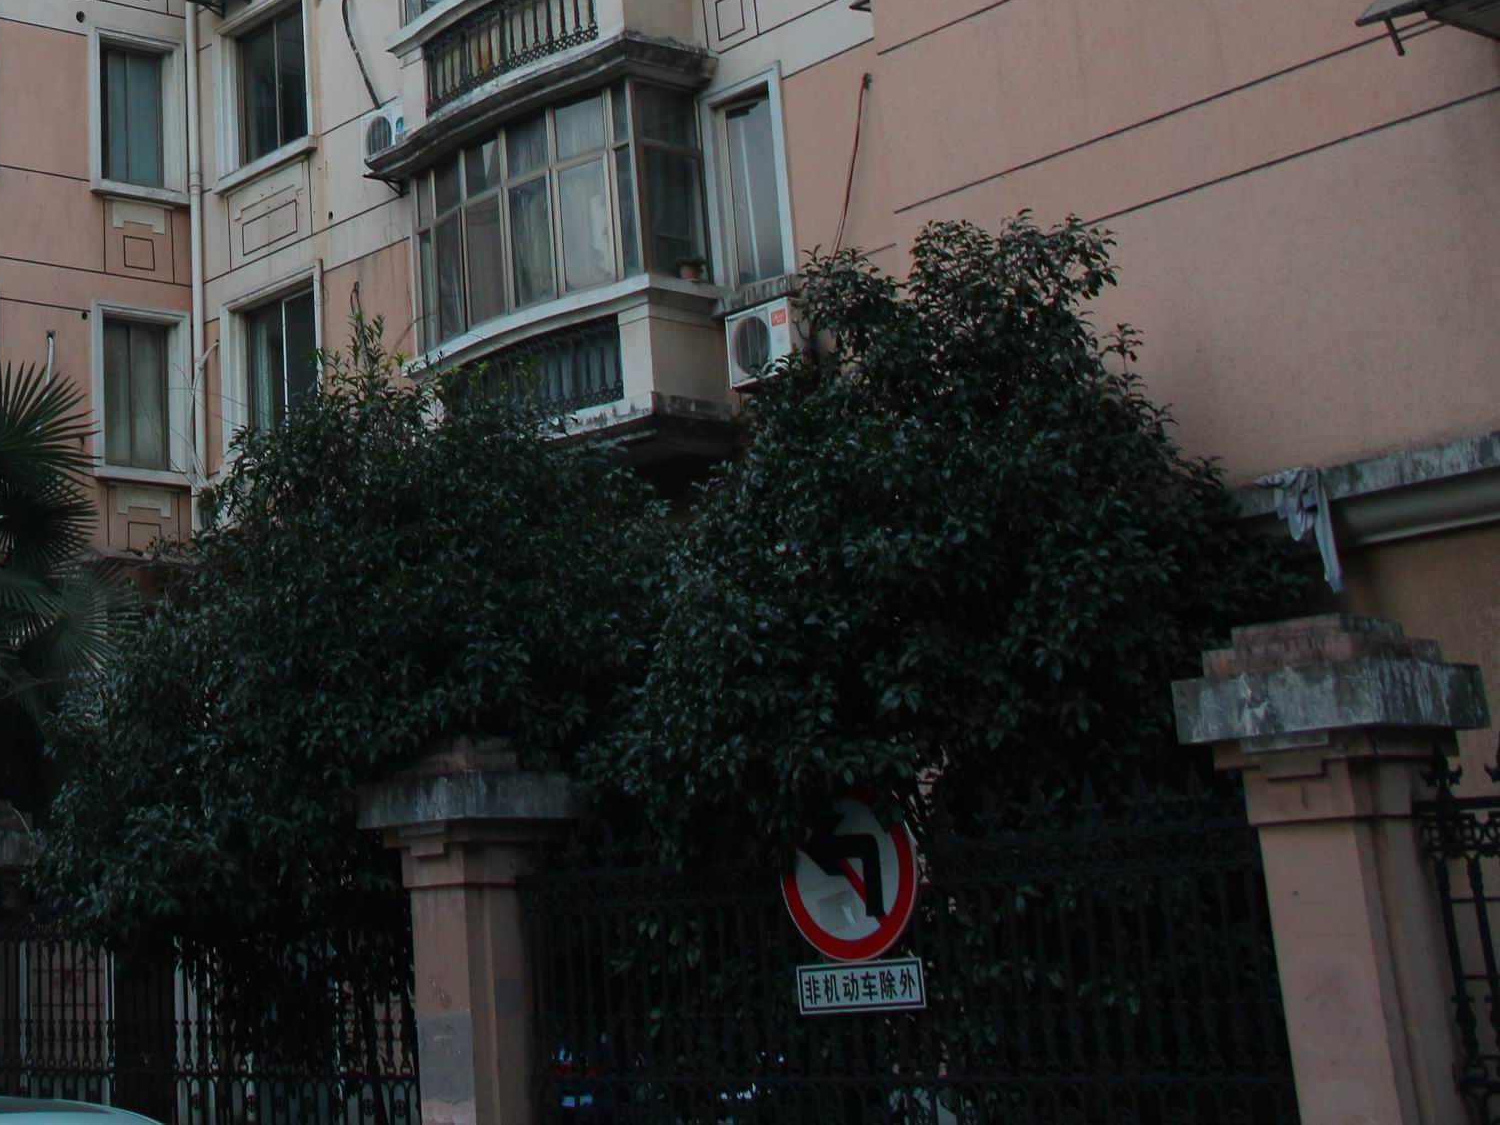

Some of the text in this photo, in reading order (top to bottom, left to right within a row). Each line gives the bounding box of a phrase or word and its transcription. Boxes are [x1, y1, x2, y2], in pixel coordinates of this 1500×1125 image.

[804, 967, 916, 1005] 非机动车除外
